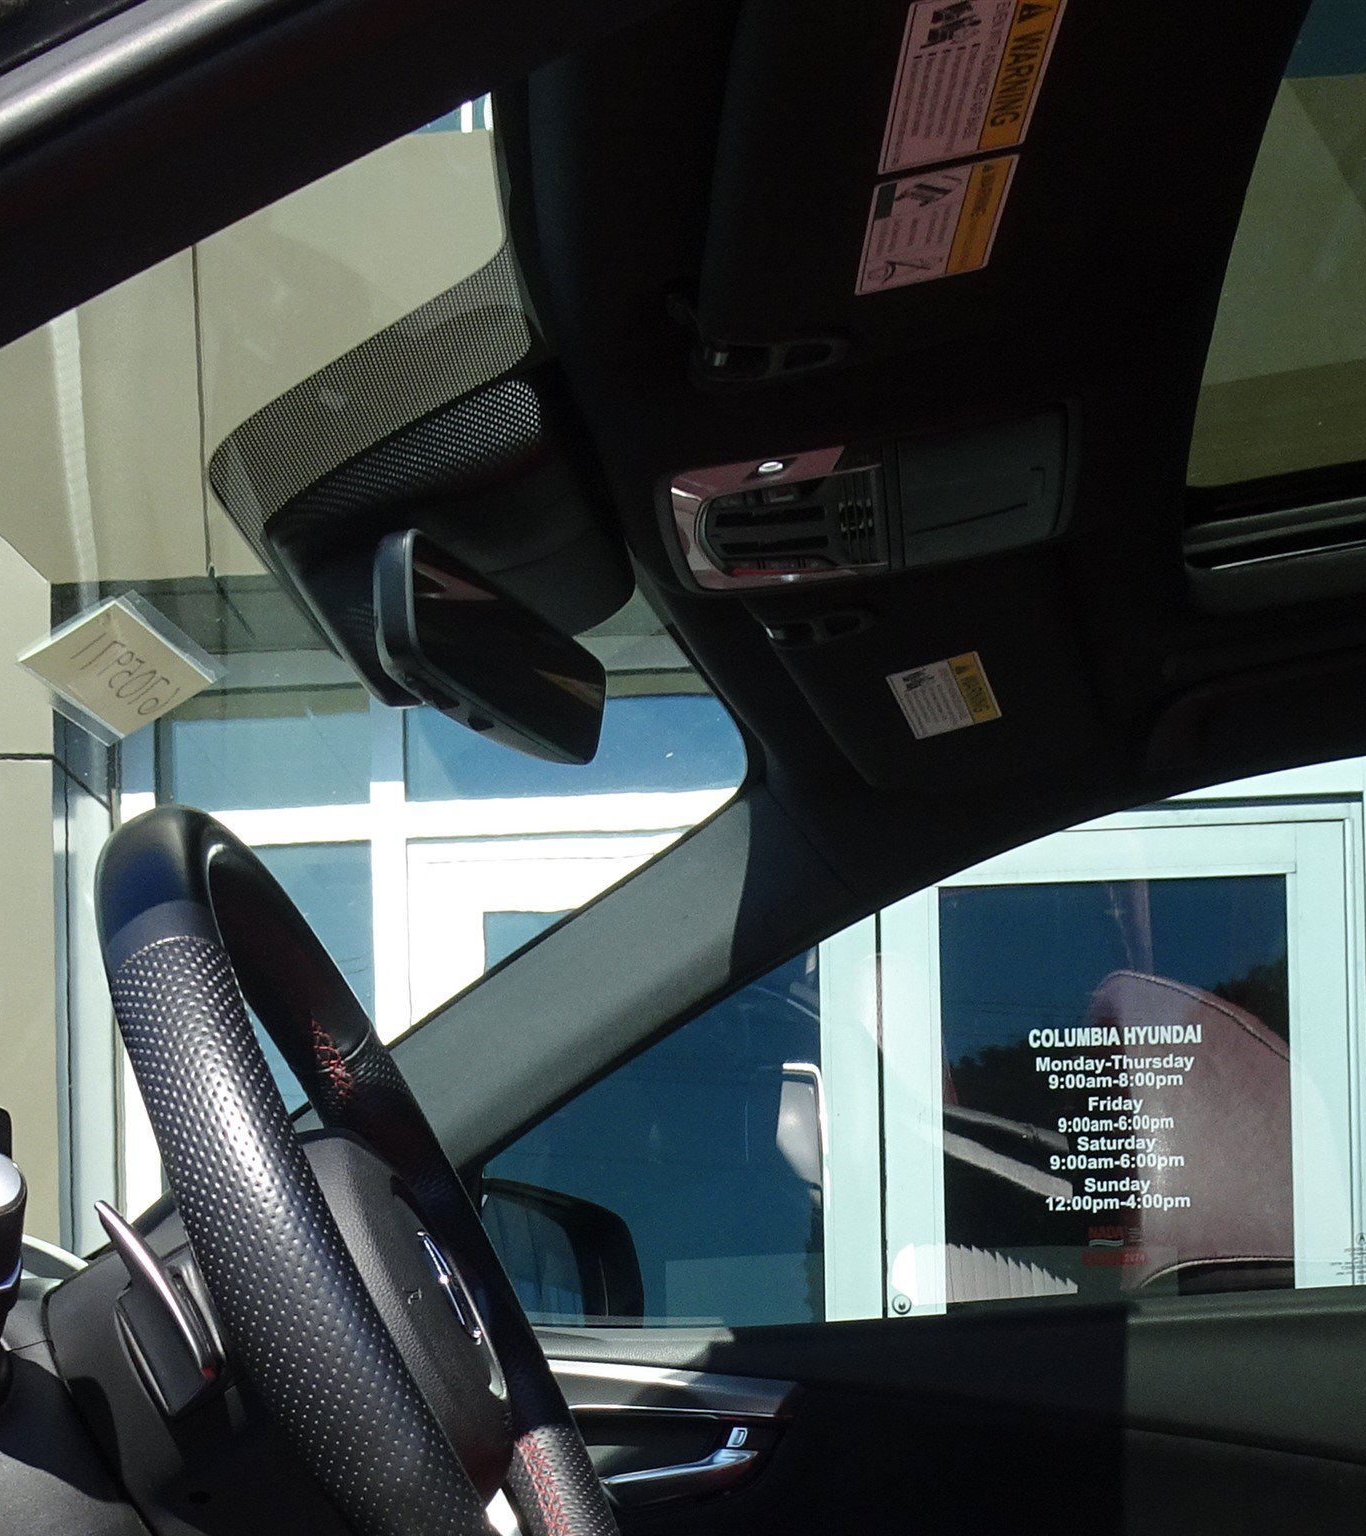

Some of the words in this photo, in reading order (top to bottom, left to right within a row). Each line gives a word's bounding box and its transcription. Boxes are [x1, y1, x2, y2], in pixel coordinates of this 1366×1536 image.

[990, 29, 1045, 128] WARNING
[1028, 1027, 1121, 1048] COLUMBIA
[1124, 1024, 1203, 1045] HYUNDAI
[1035, 1054, 1195, 1074] Monday-Thursday
[1048, 1072, 1184, 1090] 9:00am-8:00pm
[1088, 1096, 1144, 1113] Friday
[1057, 1115, 1175, 1133] 9:00am-6:00pm
[1076, 1135, 1157, 1153] Saturday
[1049, 1153, 1185, 1171] 9:00am-6:00pm
[1084, 1177, 1152, 1194] Sunday
[1045, 1194, 1192, 1214] 12:00pm-4:00pm
